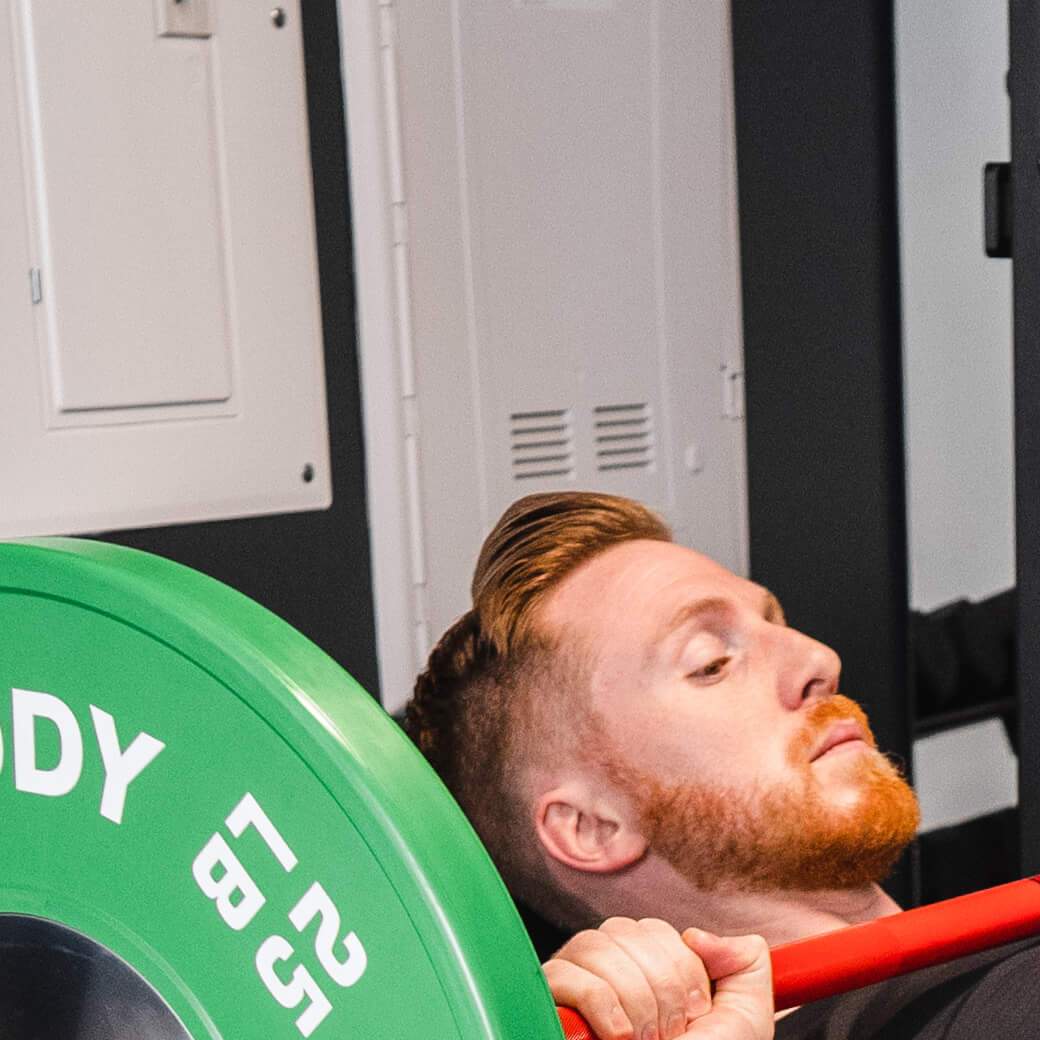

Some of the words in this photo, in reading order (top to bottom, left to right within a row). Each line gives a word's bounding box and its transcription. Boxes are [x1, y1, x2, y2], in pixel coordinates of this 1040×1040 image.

[0, 687, 167, 825] DY
[191, 791, 299, 931] LB
[254, 880, 368, 1039] 25
